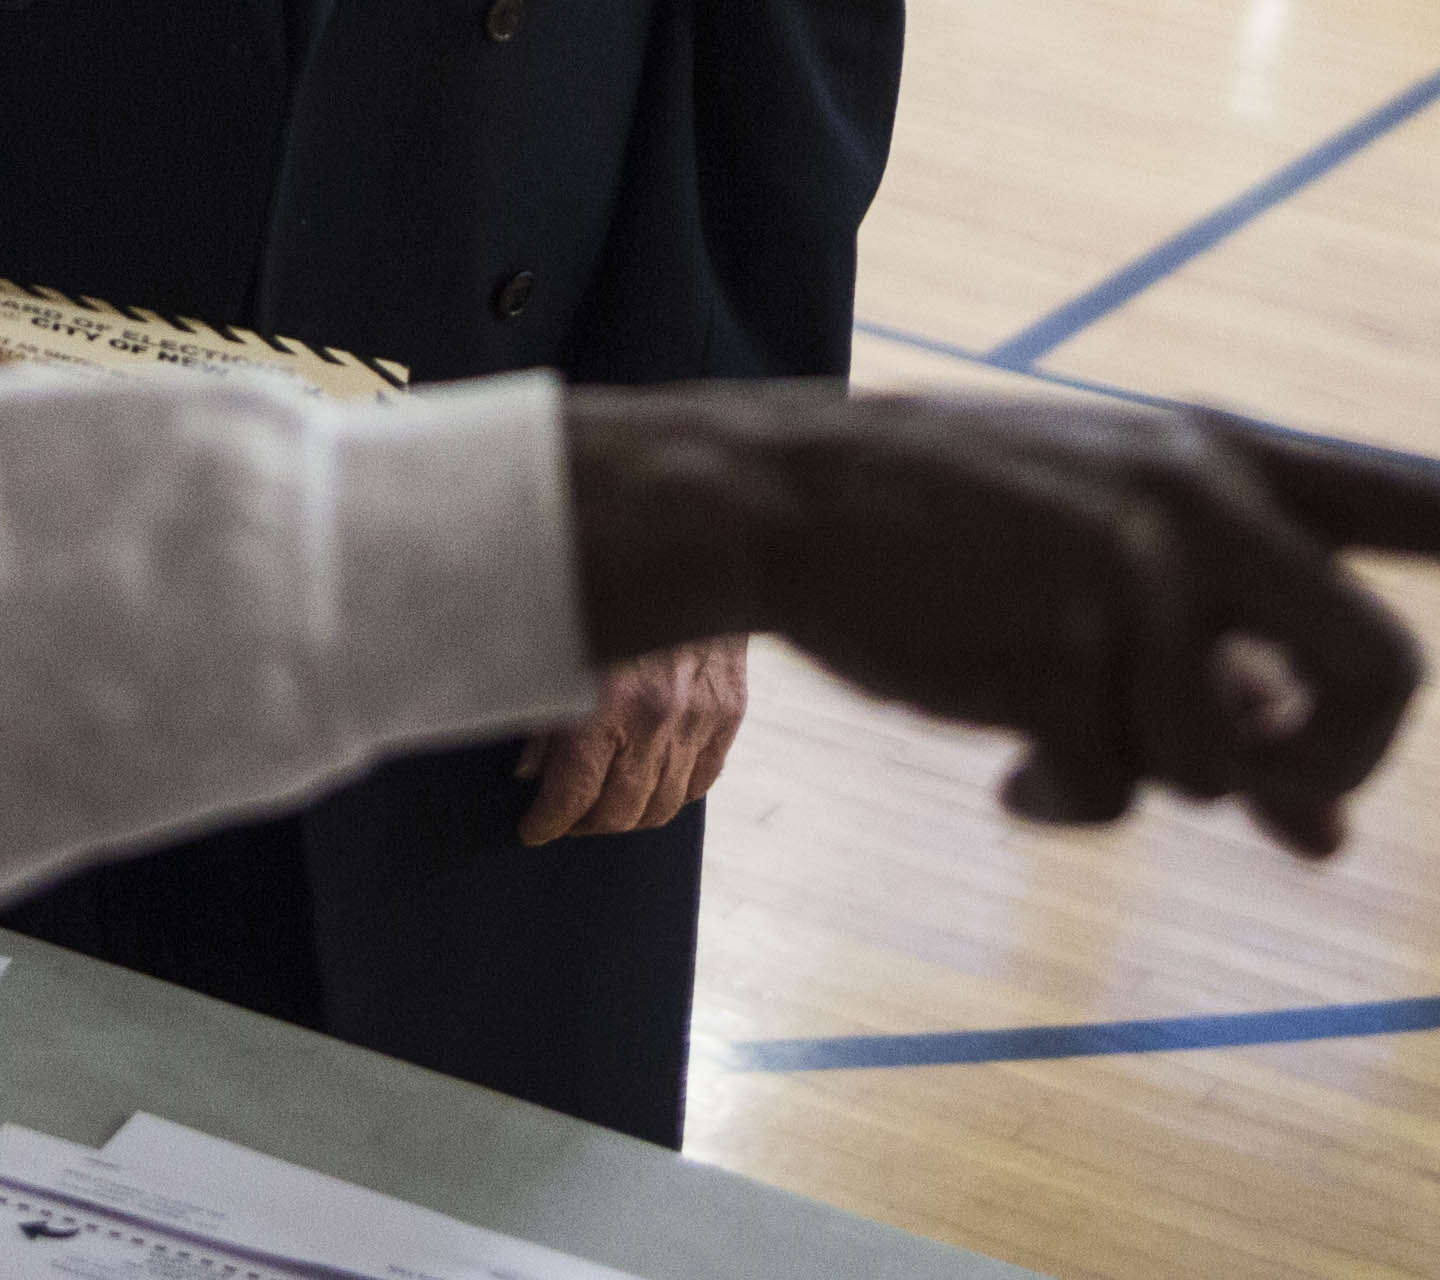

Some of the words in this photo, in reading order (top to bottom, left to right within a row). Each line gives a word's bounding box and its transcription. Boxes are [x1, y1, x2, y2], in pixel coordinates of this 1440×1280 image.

[31, 316, 100, 342] CITY
[108, 338, 147, 354] OF
[73, 316, 112, 333] OF
[122, 329, 280, 367] ELECTIO
